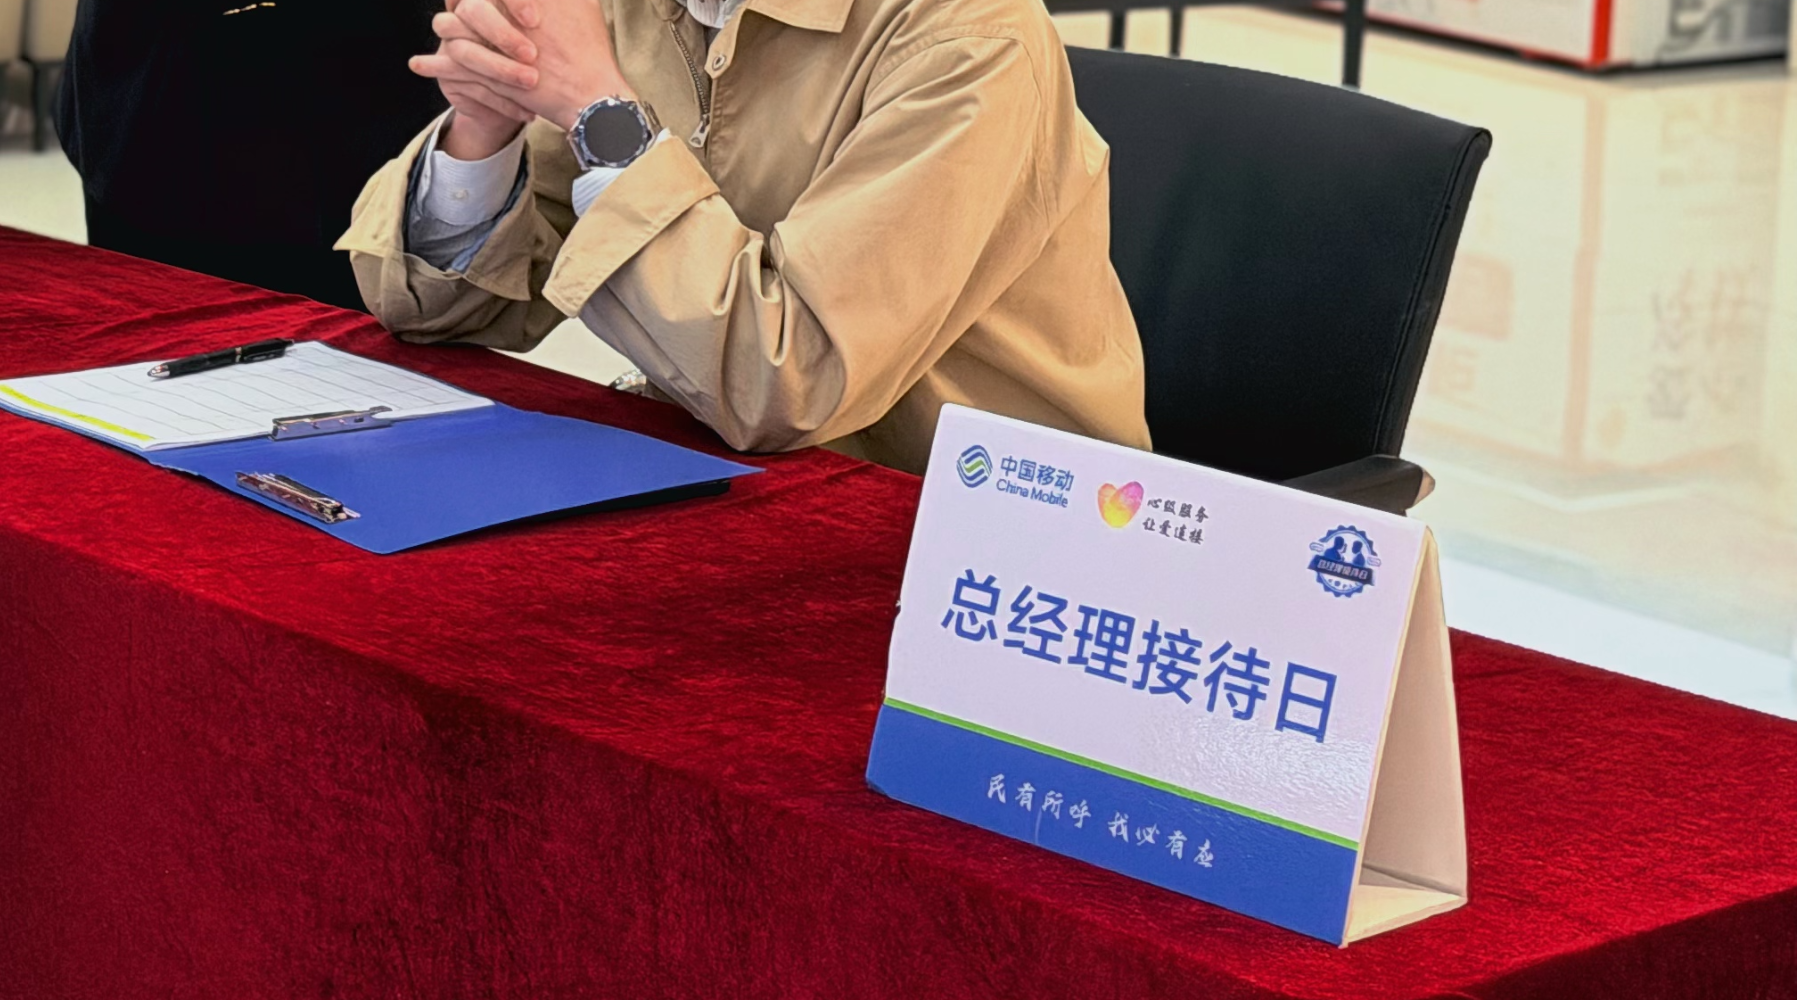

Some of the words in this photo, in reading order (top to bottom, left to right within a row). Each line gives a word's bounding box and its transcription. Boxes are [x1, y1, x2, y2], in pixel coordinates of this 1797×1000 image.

[1000, 455, 1075, 492] 中国移动
[996, 478, 1029, 498] China
[1030, 489, 1069, 508] Mobile
[1142, 517, 1204, 545] 让爱连接
[940, 568, 1339, 744] 总经理接待日
[987, 773, 1092, 829] 民有所呼
[1108, 811, 1215, 868] 我必有应
